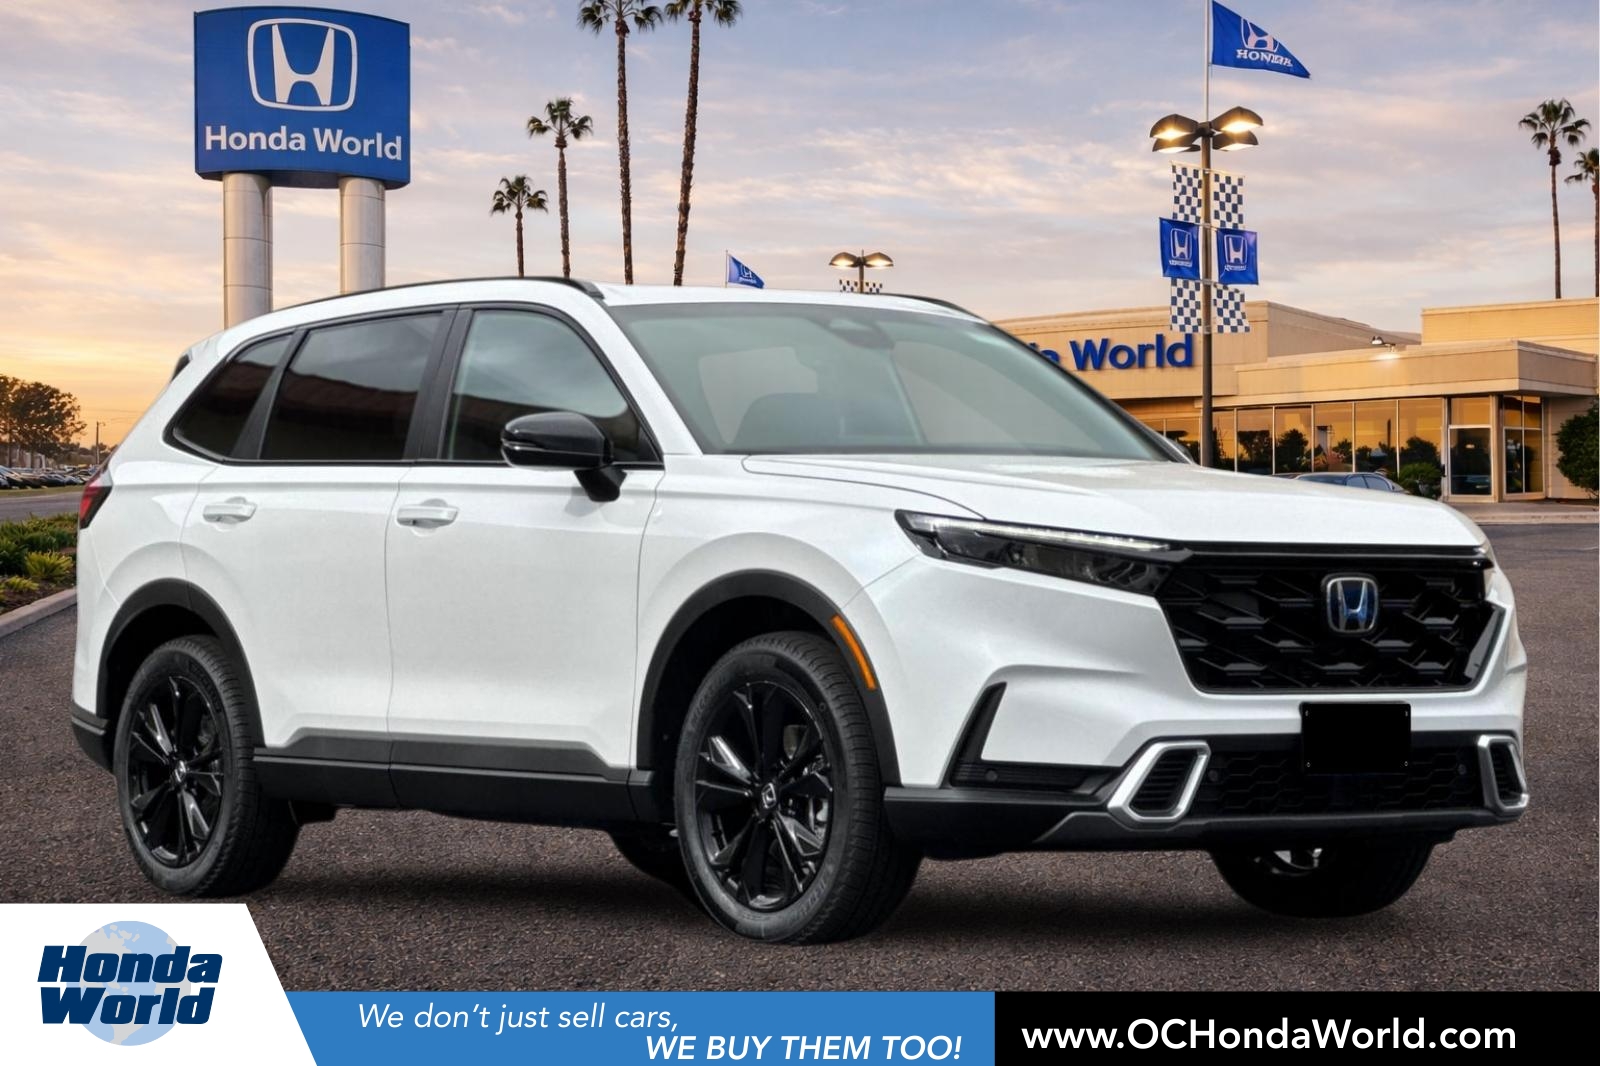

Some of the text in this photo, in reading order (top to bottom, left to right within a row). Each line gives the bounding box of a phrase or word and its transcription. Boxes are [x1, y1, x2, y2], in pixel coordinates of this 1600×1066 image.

[205, 125, 402, 161] Honda World
[1069, 333, 1193, 372] World
